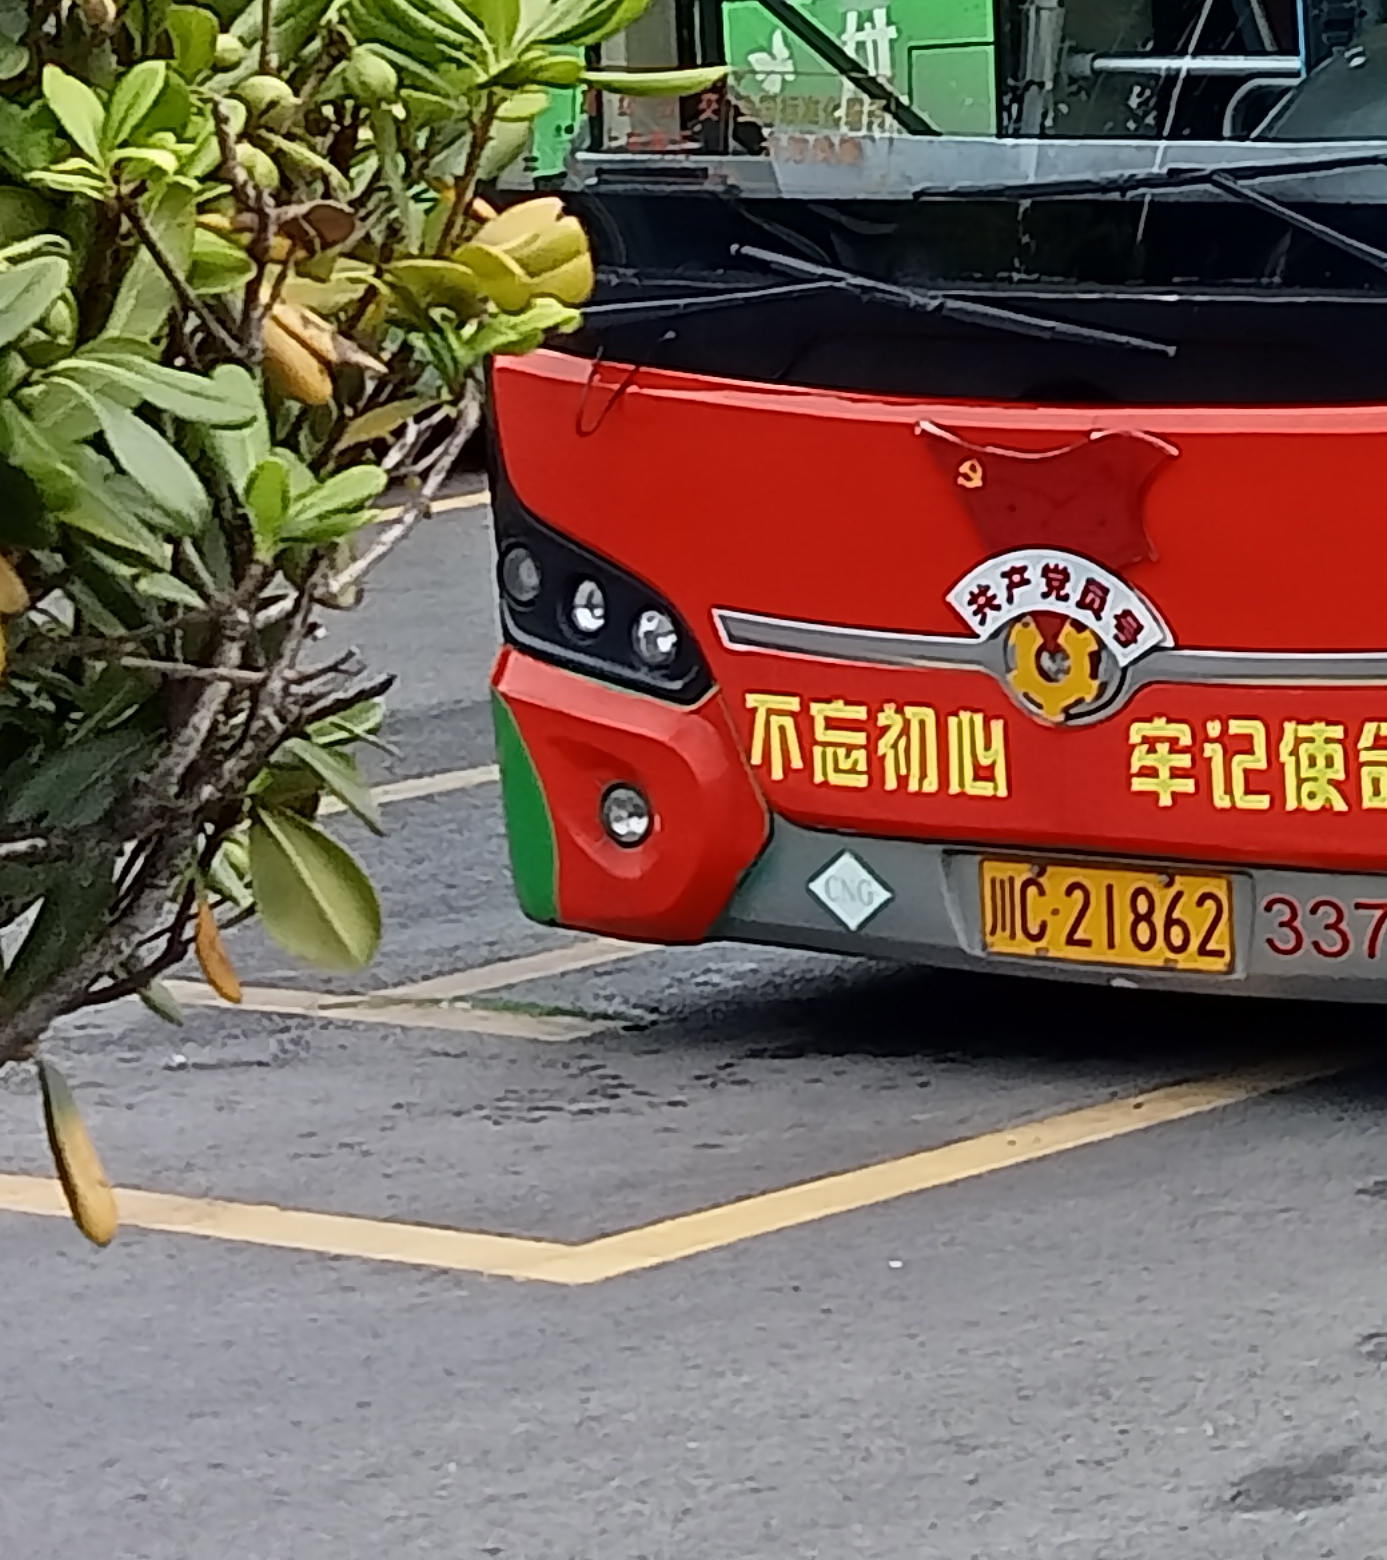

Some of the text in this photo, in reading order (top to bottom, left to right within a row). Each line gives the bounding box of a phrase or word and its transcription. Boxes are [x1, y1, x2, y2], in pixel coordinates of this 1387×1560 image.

[966, 562, 1145, 649] 共产党员号
[745, 691, 1010, 799] 不忘初心
[824, 874, 875, 908] CNG
